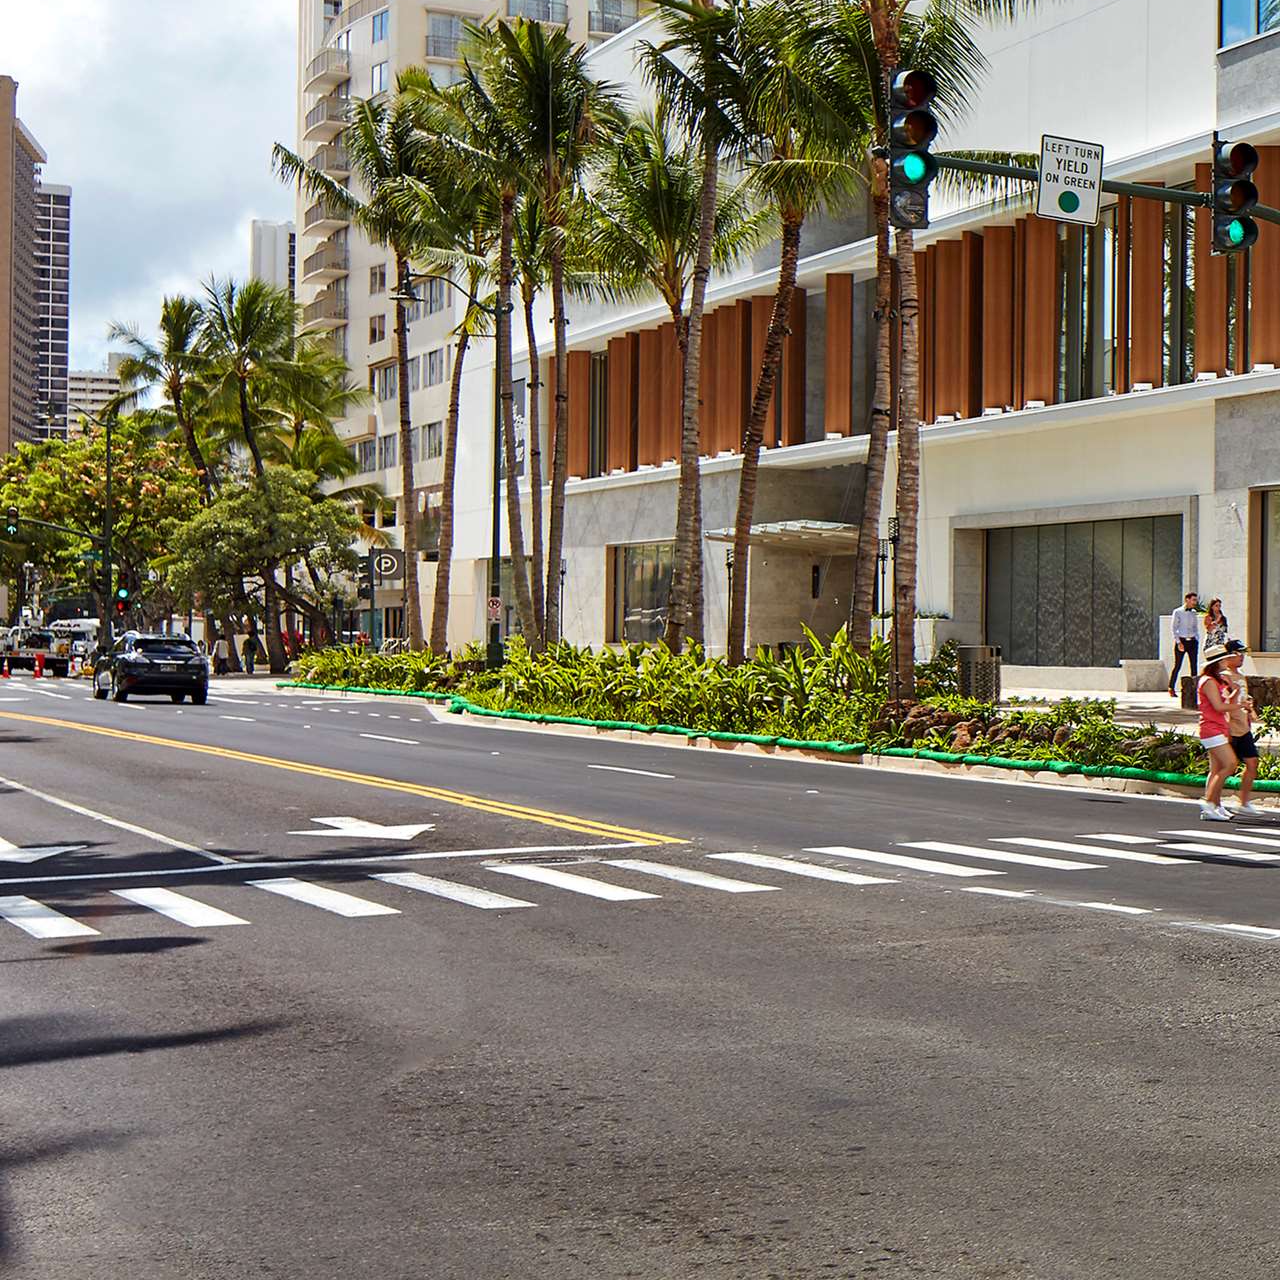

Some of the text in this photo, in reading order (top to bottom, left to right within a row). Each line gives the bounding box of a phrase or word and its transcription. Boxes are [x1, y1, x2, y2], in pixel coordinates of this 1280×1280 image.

[1045, 142, 1100, 160] LEFT TURN
[1056, 158, 1088, 175] YIELD
[1045, 173, 1096, 190] ON GREEN
